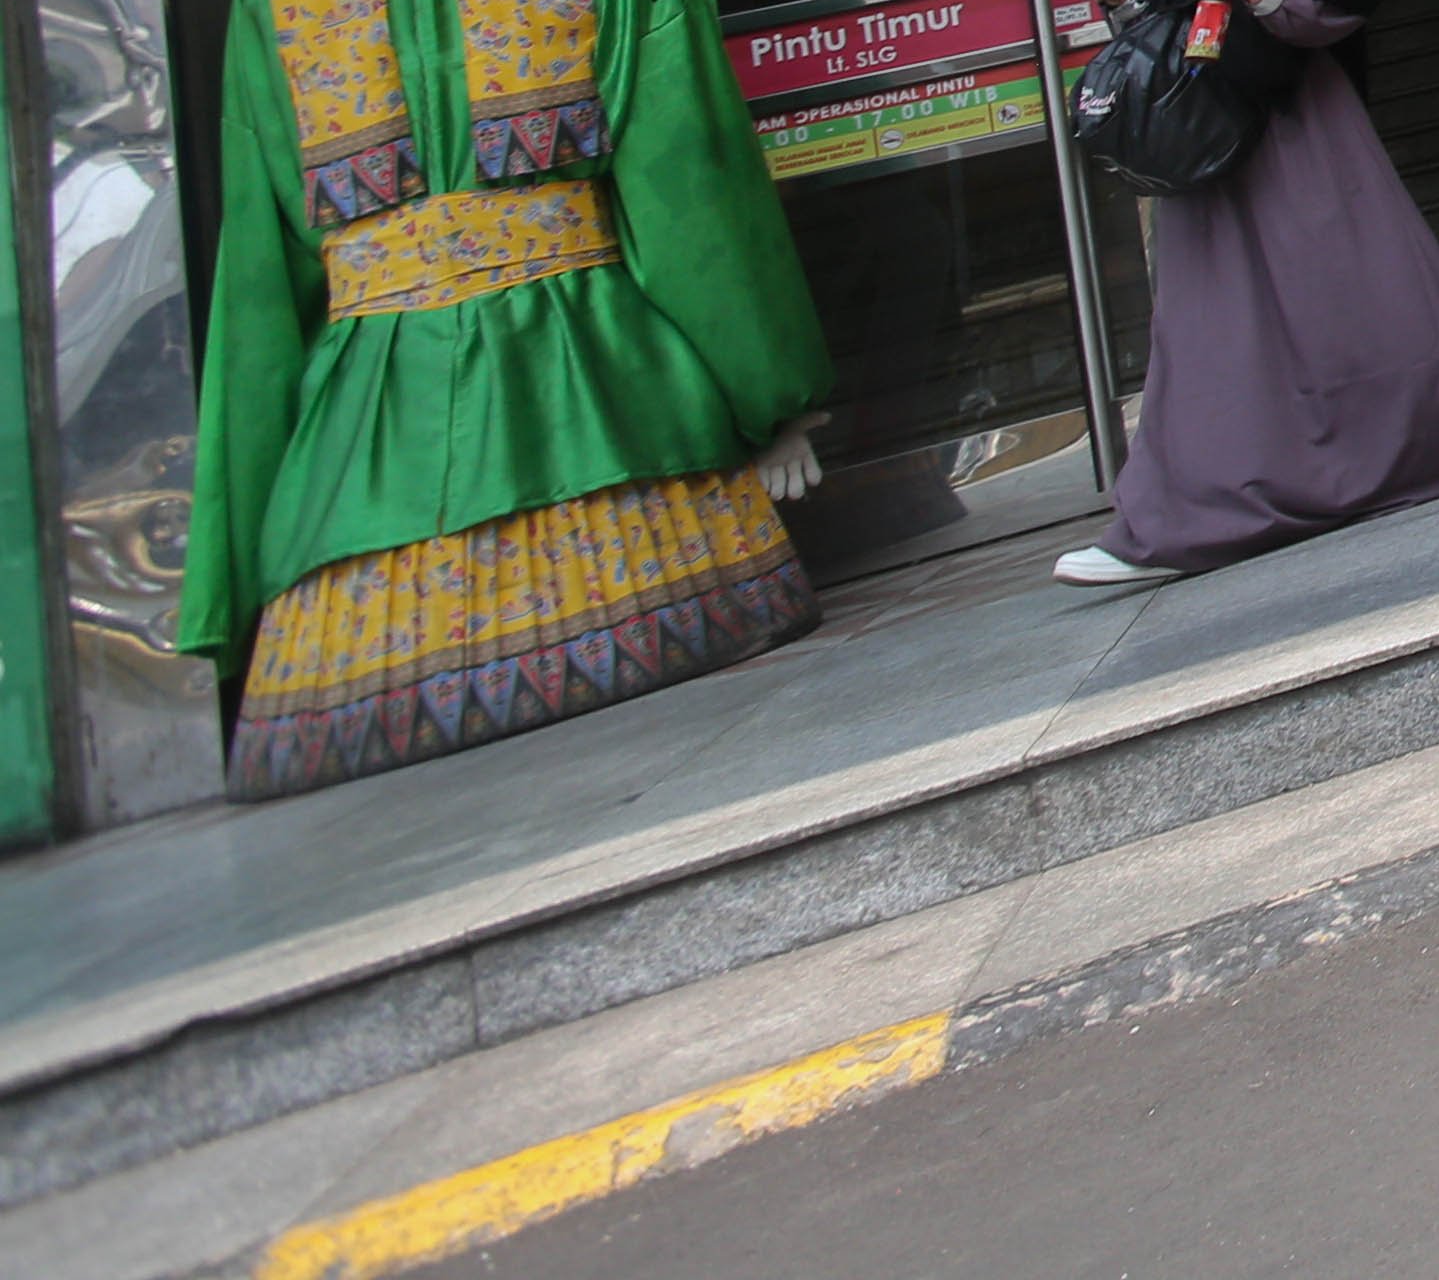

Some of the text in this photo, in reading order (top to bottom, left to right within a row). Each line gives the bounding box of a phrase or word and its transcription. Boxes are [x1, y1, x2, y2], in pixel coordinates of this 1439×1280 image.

[751, 0, 965, 69] Pintu Timur
[826, 44, 898, 76] Lt. SLG
[756, 75, 976, 133] AM OPERASIONAL PINTU
[854, 99, 934, 130] 17.00
[949, 85, 998, 109] WIB
